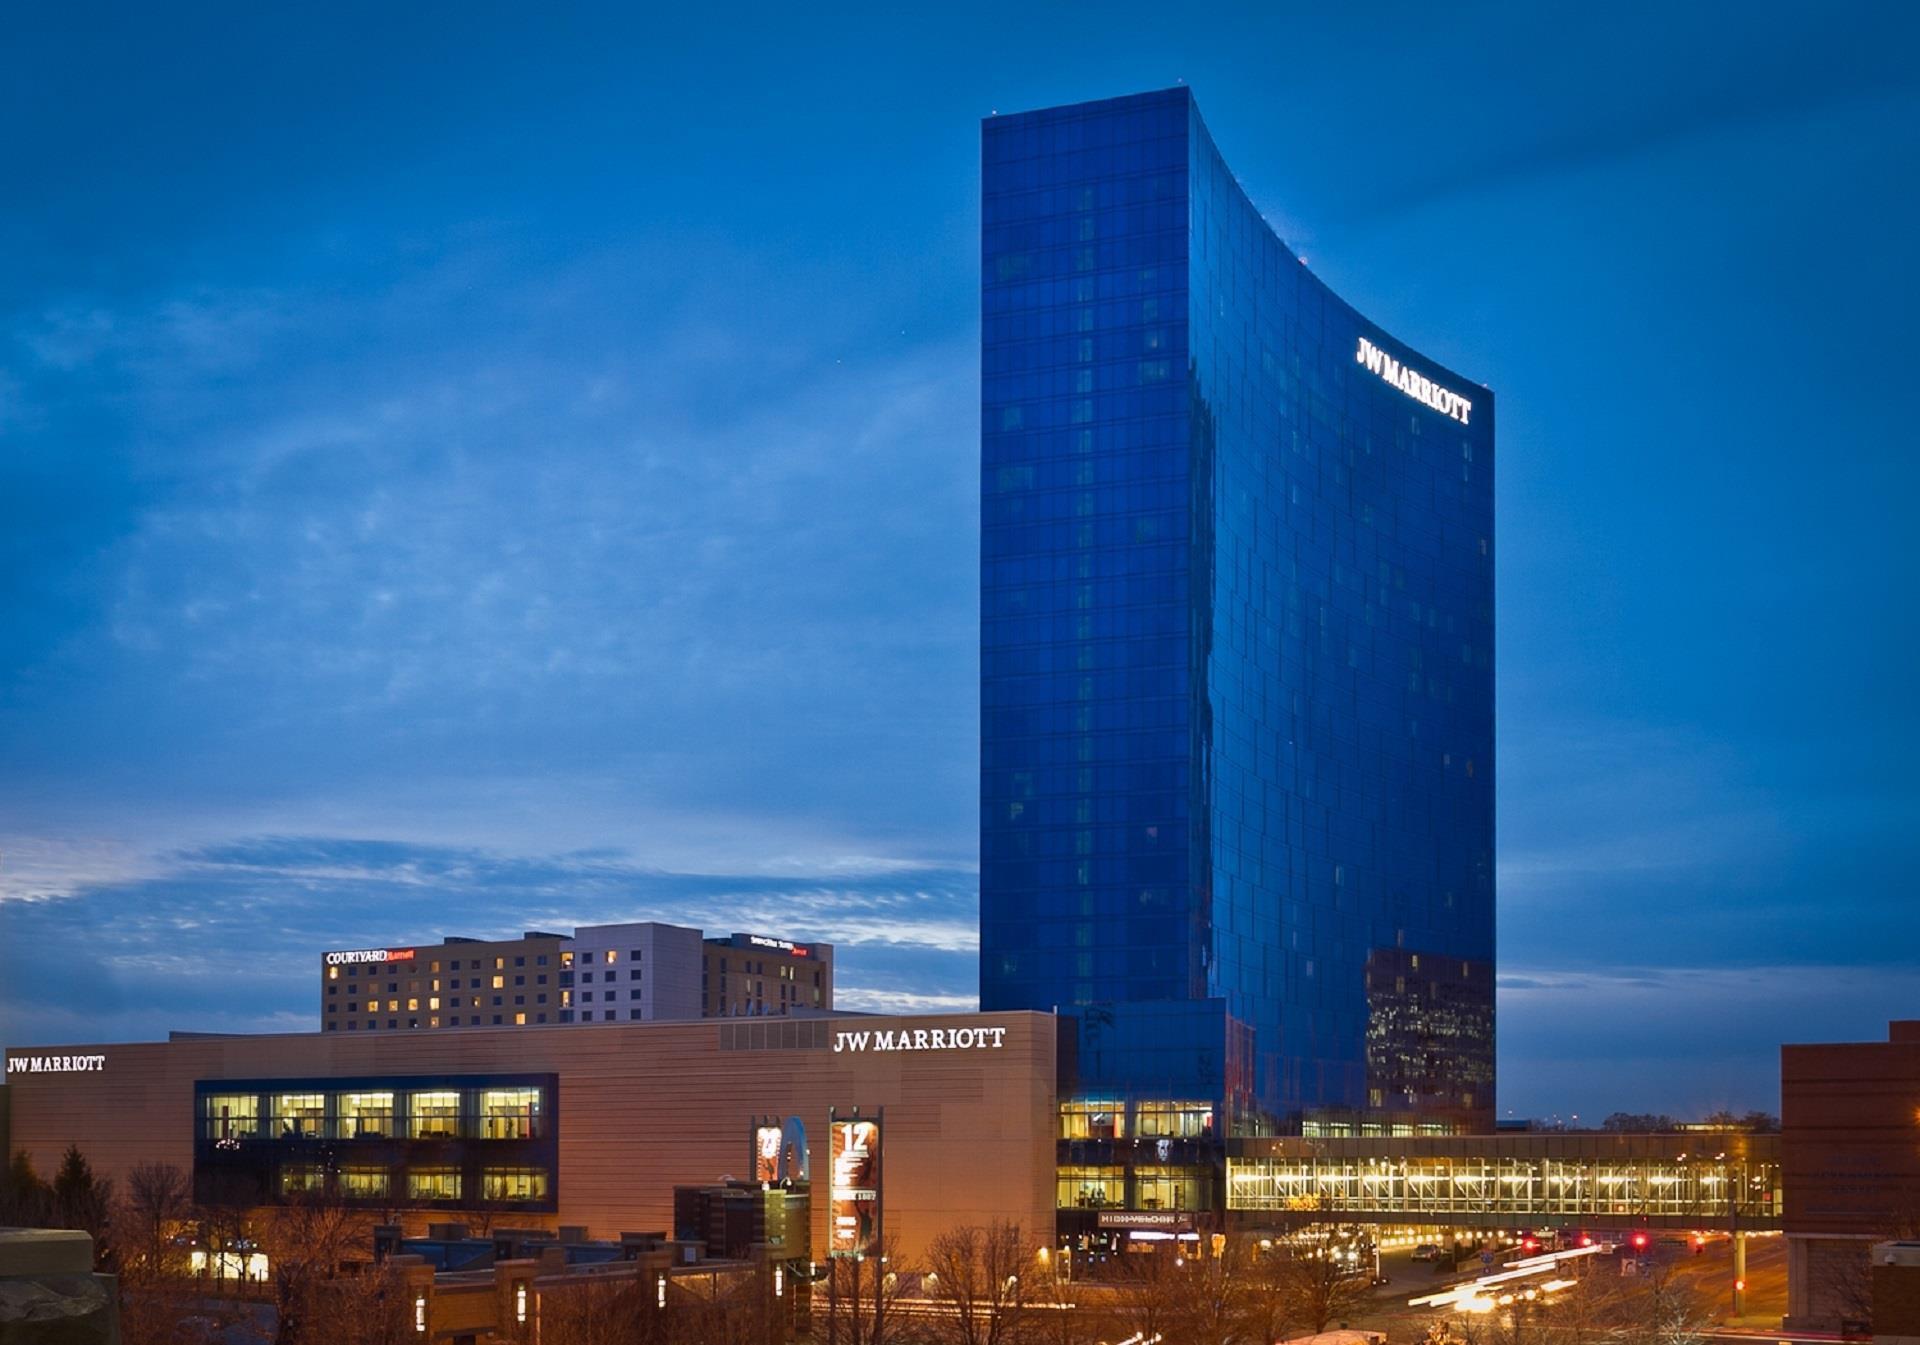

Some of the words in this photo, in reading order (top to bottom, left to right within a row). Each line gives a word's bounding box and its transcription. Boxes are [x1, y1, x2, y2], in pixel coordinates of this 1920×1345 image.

[1356, 337, 1382, 375] JW
[1382, 354, 1472, 425] MARRIOTT
[326, 950, 387, 965] COURTYARD
[833, 1031, 870, 1053] JW
[873, 1027, 1006, 1051] MARRIOTT
[7, 1057, 29, 1073] JW
[29, 1055, 105, 1072] MARRIOTT
